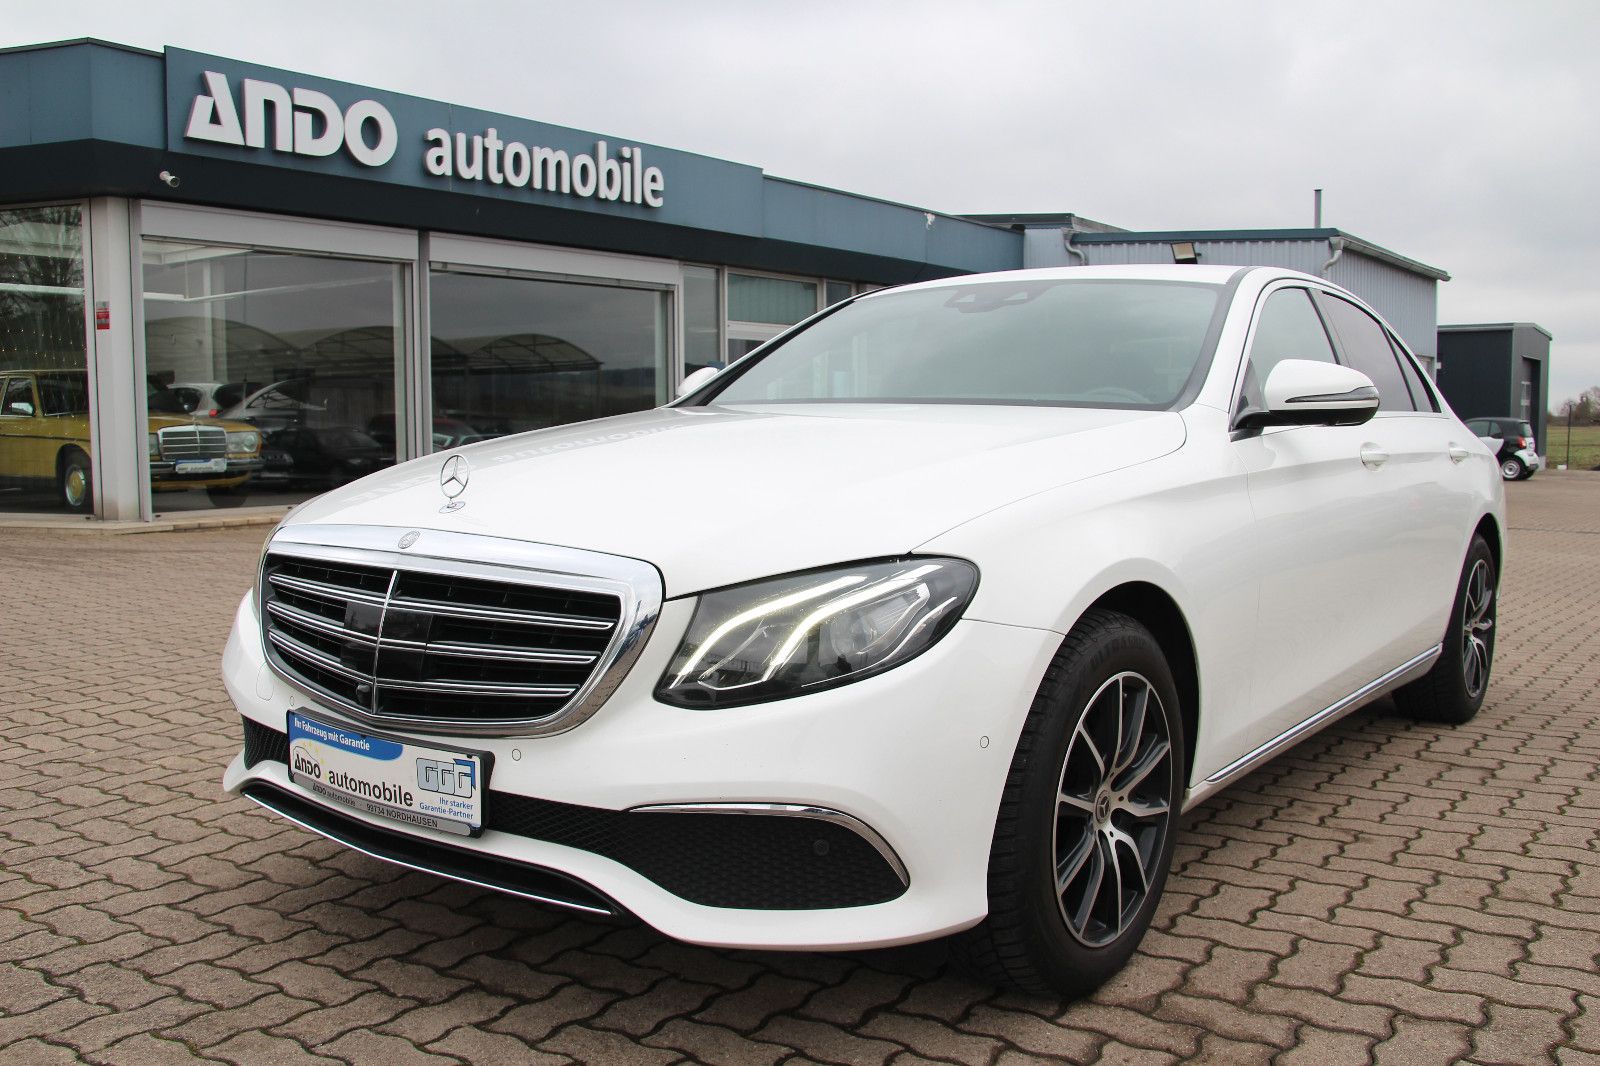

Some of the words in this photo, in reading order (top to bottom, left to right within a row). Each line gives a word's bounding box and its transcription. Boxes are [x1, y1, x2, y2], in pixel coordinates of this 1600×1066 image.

[184, 71, 398, 167] ANDO
[425, 127, 665, 208] automobile
[302, 720, 327, 740] Fahrzeug
[328, 731, 339, 743] mit
[339, 734, 370, 751] Garantie
[294, 753, 321, 779] ANDO
[328, 769, 414, 807] automobile
[419, 802, 473, 820] Garantie-Partner
[439, 797, 449, 806] Ihr
[450, 800, 474, 810] starker
[386, 807, 438, 828] NORDHAUSEN
